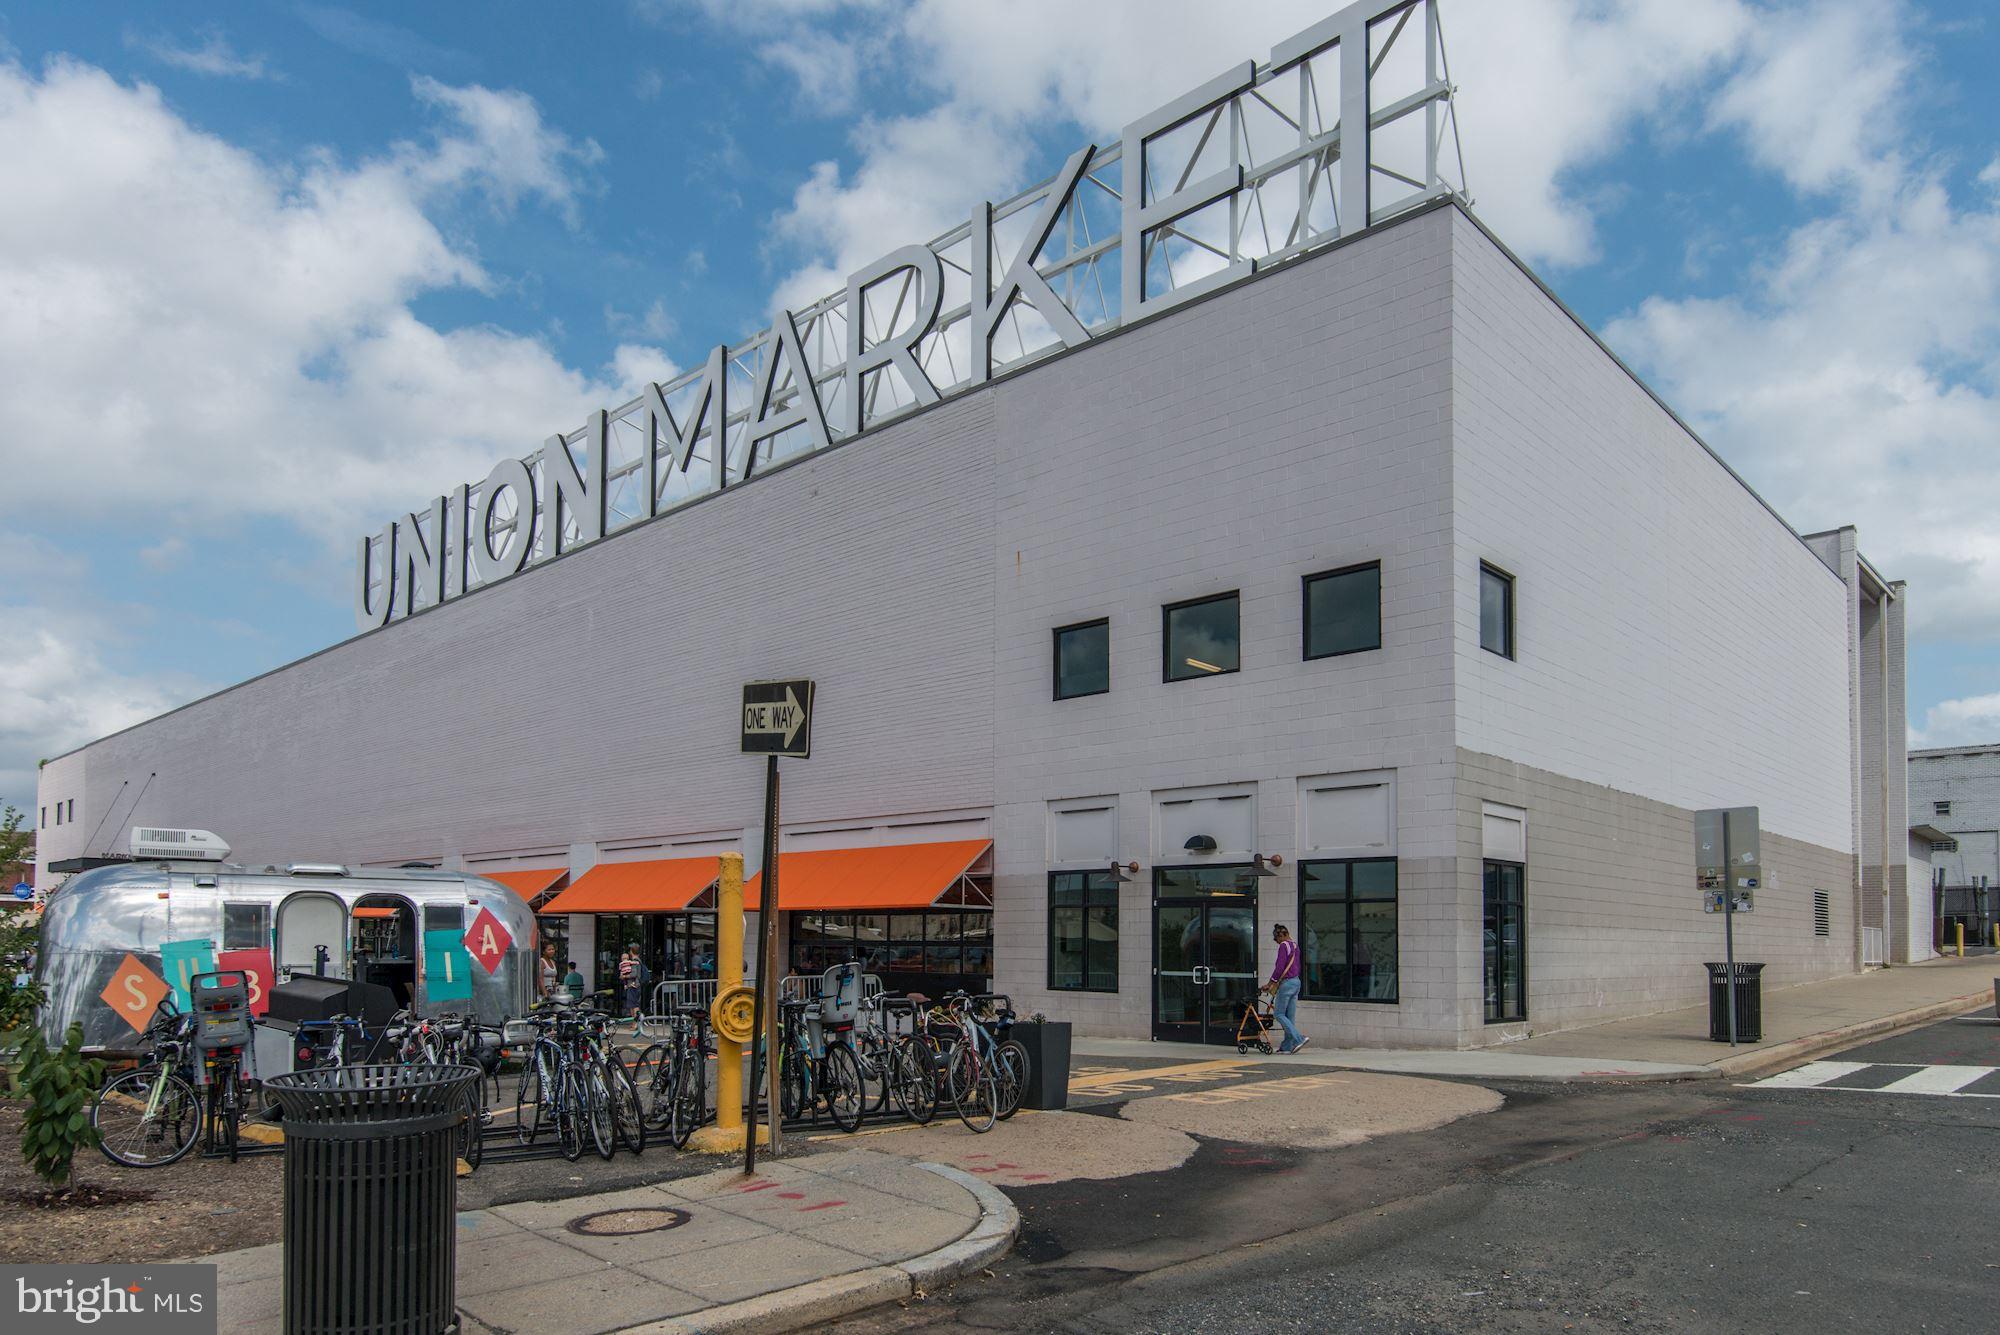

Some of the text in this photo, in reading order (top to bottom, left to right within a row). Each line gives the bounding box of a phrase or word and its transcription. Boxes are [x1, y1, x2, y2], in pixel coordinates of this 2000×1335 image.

[355, 0, 1424, 631] UNION MARKET
[746, 706, 796, 730] ONE WAY
